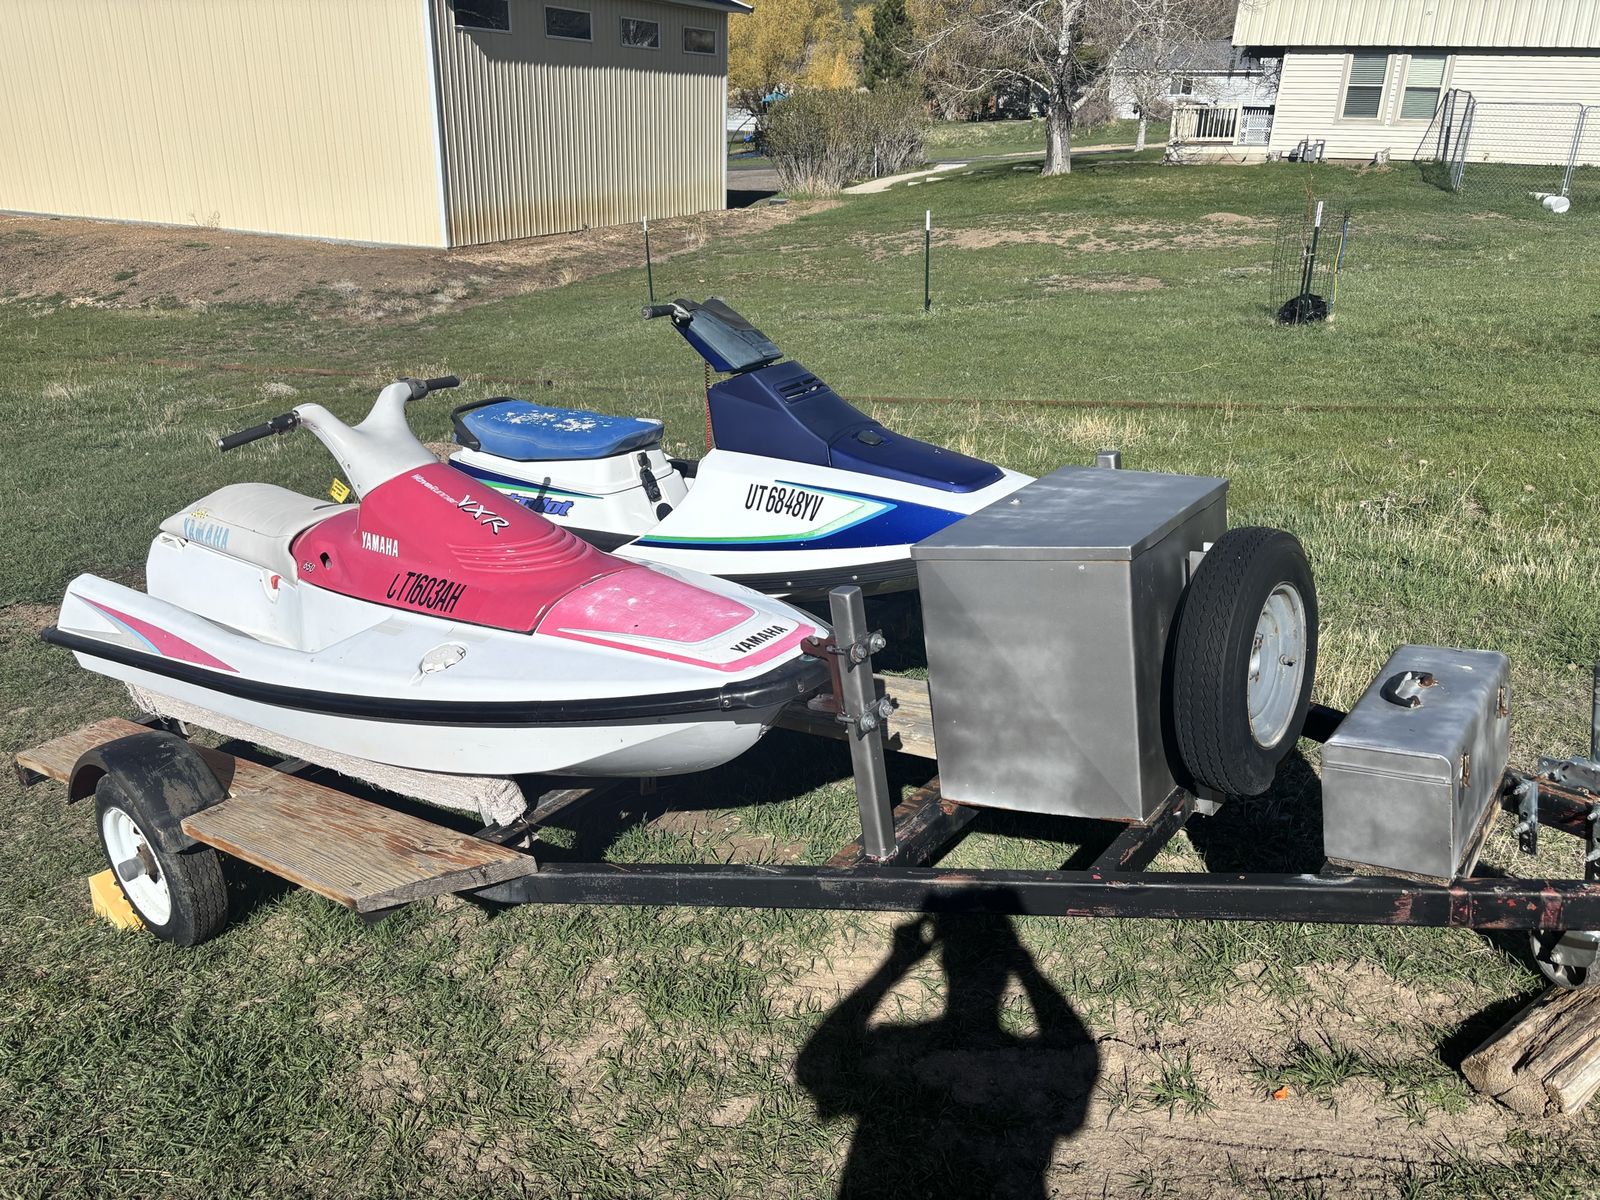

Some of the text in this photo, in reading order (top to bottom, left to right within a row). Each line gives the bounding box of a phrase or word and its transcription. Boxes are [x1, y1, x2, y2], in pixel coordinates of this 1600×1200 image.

[457, 494, 510, 536] VXR
[183, 517, 230, 551] YAMAHA
[361, 530, 399, 558] YAMAHA
[729, 625, 789, 654] YAMAHA
